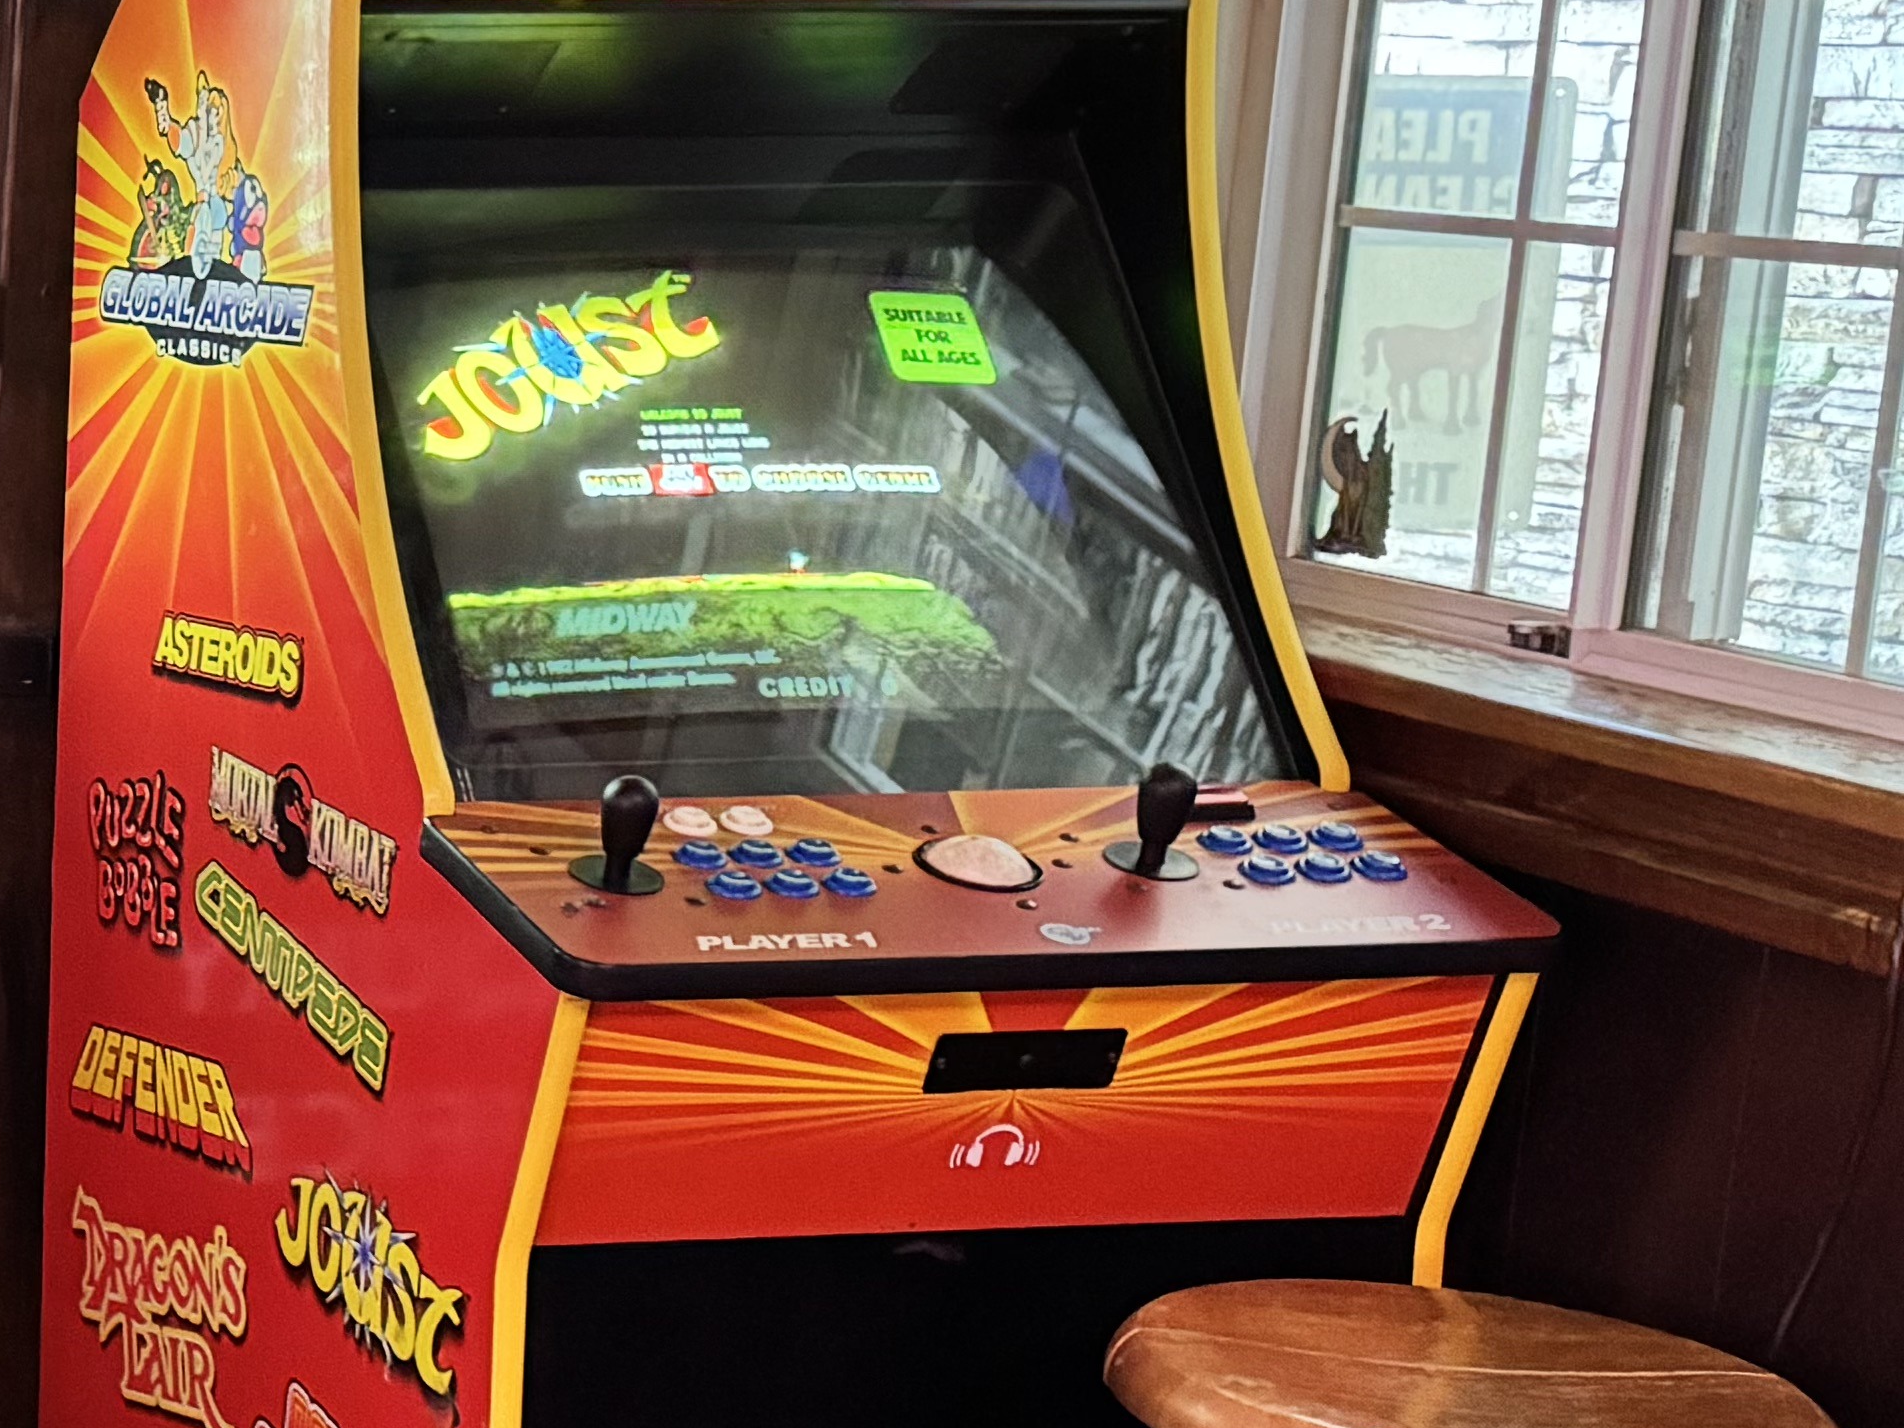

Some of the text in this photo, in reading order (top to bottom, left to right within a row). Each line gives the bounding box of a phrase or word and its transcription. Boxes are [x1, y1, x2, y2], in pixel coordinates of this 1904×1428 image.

[103, 267, 313, 344] GLOBAL ARCADE
[882, 308, 968, 325] SUITABLE
[914, 328, 953, 344] FOR
[155, 336, 243, 367] CLASSICS
[901, 348, 982, 365] ALL AGES
[154, 612, 302, 698] ASTEROIDS
[554, 599, 696, 638] MIDWAY
[88, 770, 184, 867] PUZZLE
[208, 745, 398, 916] MORTAL KOMBAT
[96, 856, 180, 949] BOBBLE
[697, 930, 879, 953] PLAYER 1
[1418, 913, 1453, 933] 2
[195, 858, 389, 1094] CENTIPEDE
[71, 1024, 252, 1175] DEFENDER
[73, 1186, 248, 1340] DRAGON'S
[274, 1172, 464, 1396] JOUST
